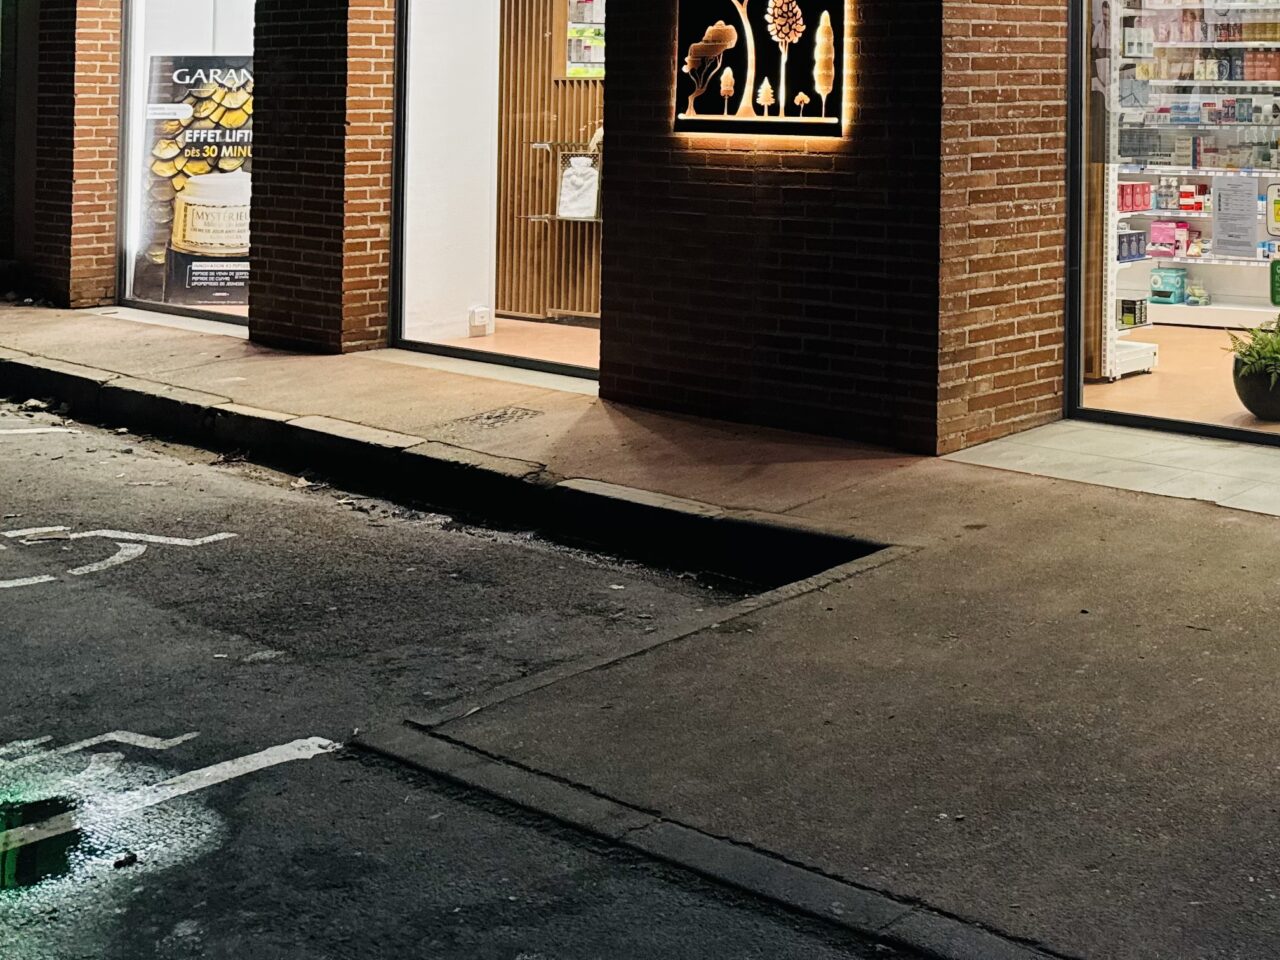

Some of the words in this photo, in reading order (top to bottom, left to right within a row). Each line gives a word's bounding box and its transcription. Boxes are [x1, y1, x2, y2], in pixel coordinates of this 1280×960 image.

[185, 129, 222, 142] EFFET
[184, 146, 201, 157] DÈS
[202, 144, 218, 157] 30
